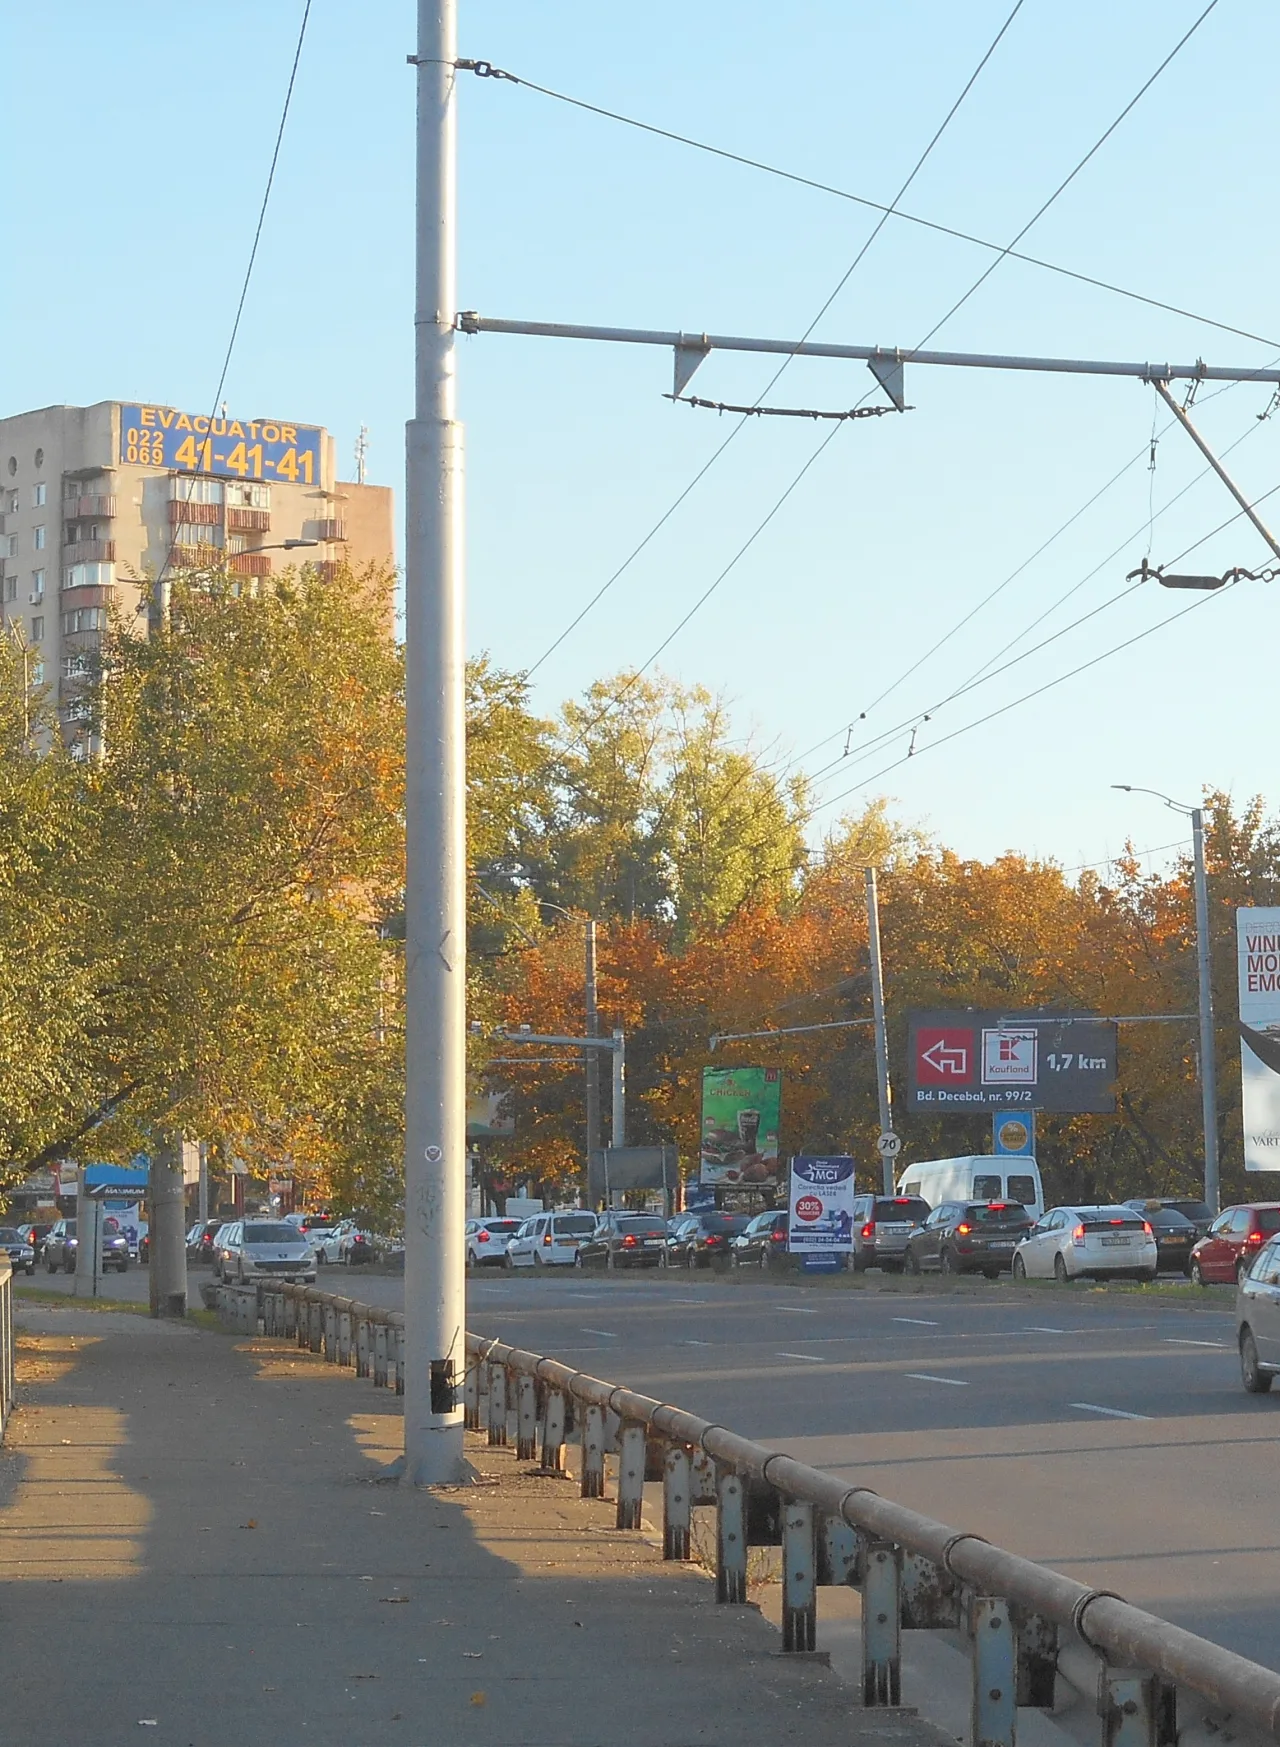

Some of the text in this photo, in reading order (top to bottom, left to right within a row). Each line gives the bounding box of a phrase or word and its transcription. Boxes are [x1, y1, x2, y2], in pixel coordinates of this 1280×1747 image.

[141, 408, 297, 444] EVACUATOR
[127, 428, 164, 448] 022
[127, 446, 163, 466] 069
[175, 435, 313, 484] 41-41-41
[1046, 1054, 1106, 1071] 1,7 km
[989, 1065, 1029, 1074] Kaufland
[710, 1089, 751, 1097] CHICKEN
[917, 1091, 1032, 1102] Bd. Decebal, nr. 99/2
[882, 1139, 896, 1150] 70
[814, 1170, 838, 1180] MCI
[819, 1189, 837, 1197] LASER
[799, 1201, 820, 1211] 30%
